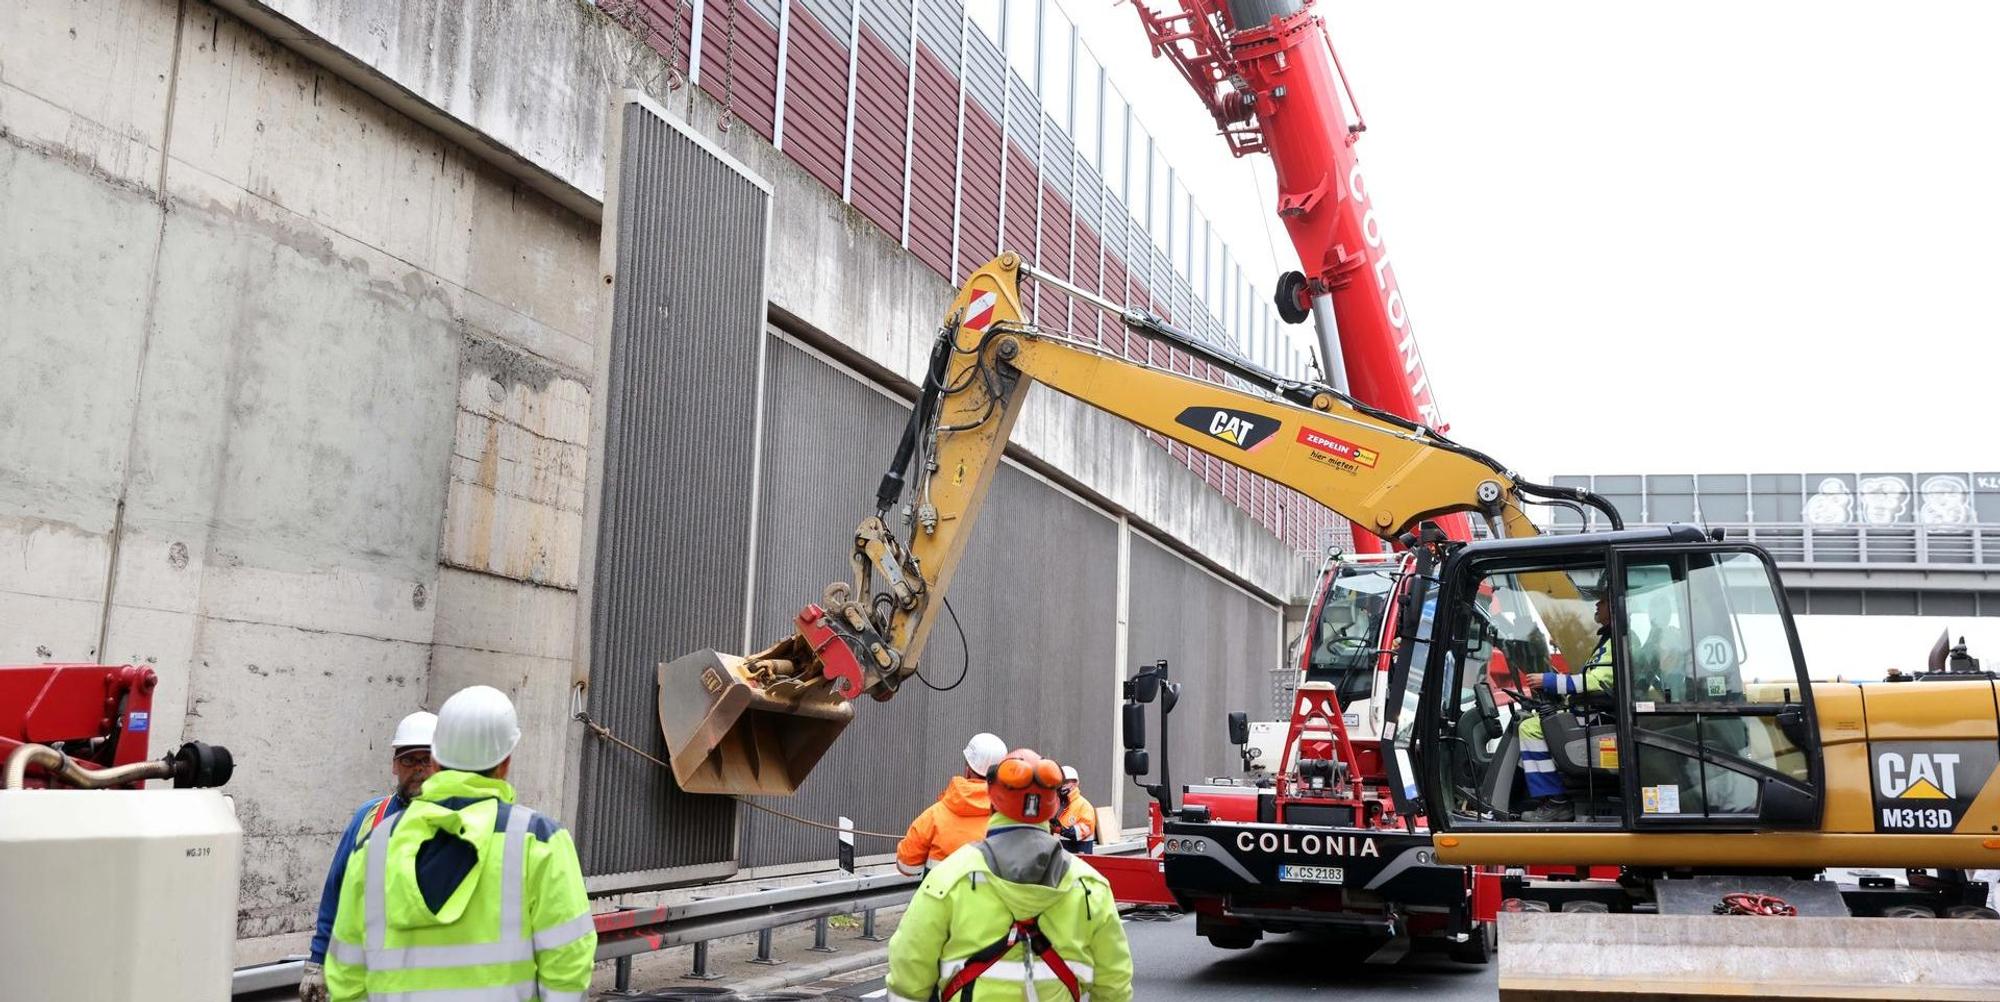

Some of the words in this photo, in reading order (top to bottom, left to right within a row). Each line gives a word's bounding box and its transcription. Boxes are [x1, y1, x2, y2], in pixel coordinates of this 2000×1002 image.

[1350, 165, 1437, 428] COLONIA
[1209, 411, 1254, 446] CAT
[1307, 434, 1349, 453] ZEPPELIN
[1310, 450, 1326, 461] hier
[1704, 642, 1726, 665] 20
[1878, 752, 1960, 799] CAT
[1882, 808, 1953, 828] M313D
[1236, 831, 1379, 858] COLONIA
[1315, 868, 1342, 880] 2183
